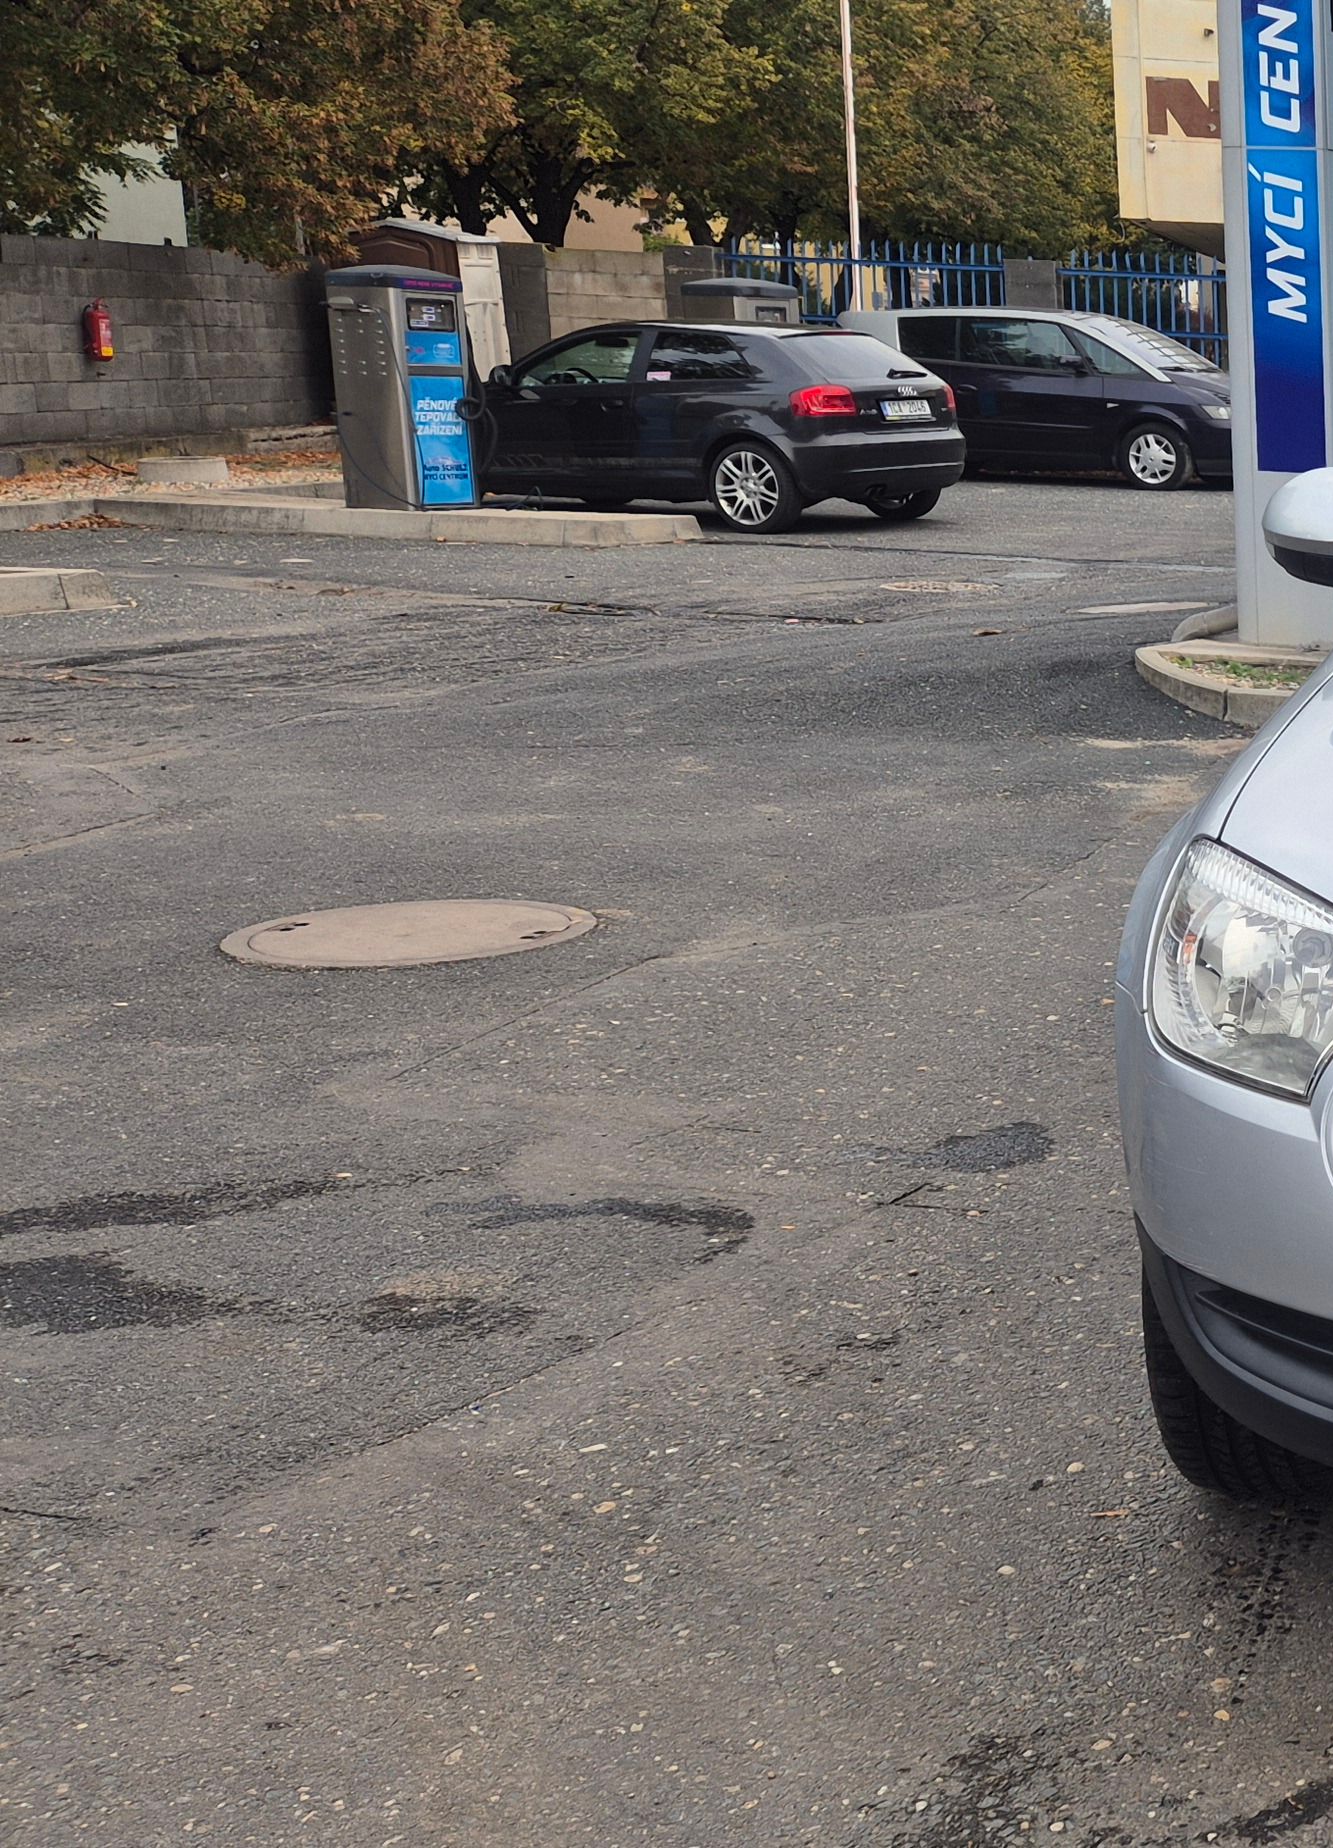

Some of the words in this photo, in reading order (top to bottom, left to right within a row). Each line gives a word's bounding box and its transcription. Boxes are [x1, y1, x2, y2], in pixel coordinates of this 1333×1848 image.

[1257, 3, 1300, 133] CEN
[1248, 163, 1308, 323] MYCÍ
[415, 411, 464, 423] TEPOVAC
[417, 397, 458, 411] PĚNOVÉ
